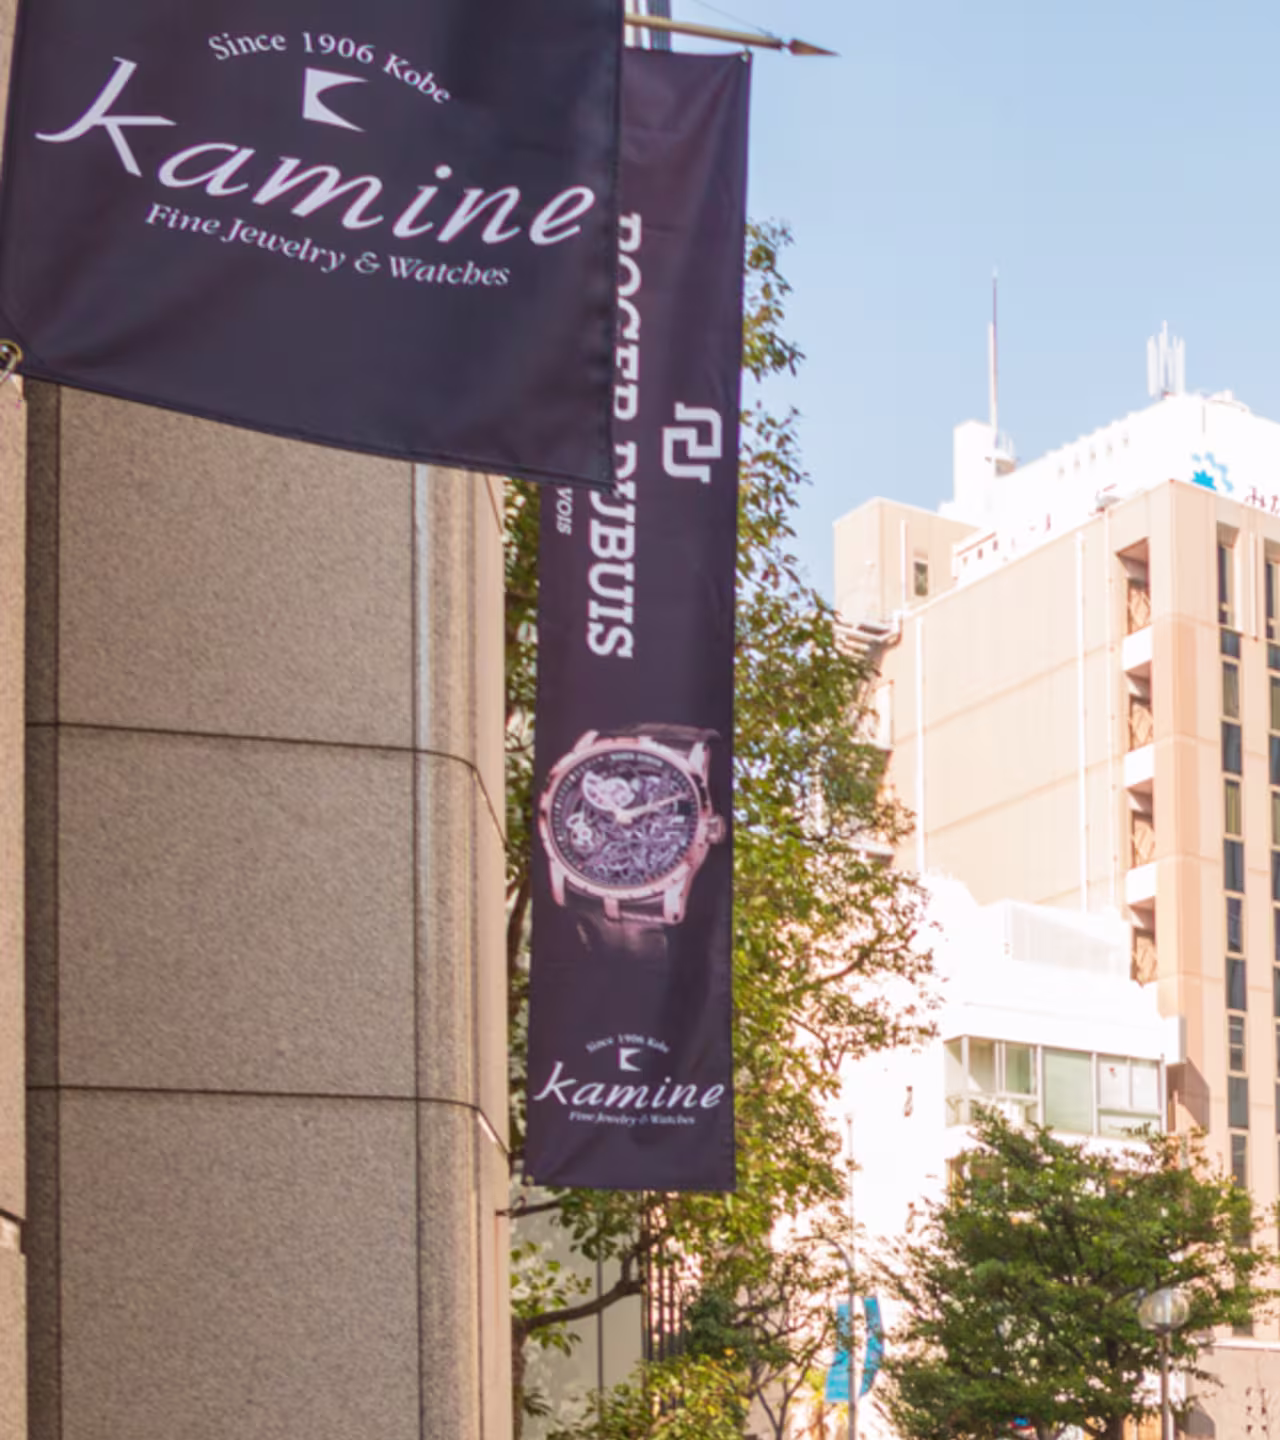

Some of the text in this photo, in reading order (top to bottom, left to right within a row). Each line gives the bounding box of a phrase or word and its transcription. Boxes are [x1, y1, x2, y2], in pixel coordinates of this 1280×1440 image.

[208, 31, 450, 104] Since 1906 Kobe
[145, 203, 511, 286] Fine Jewelry & Watches
[555, 487, 574, 536] VOIS
